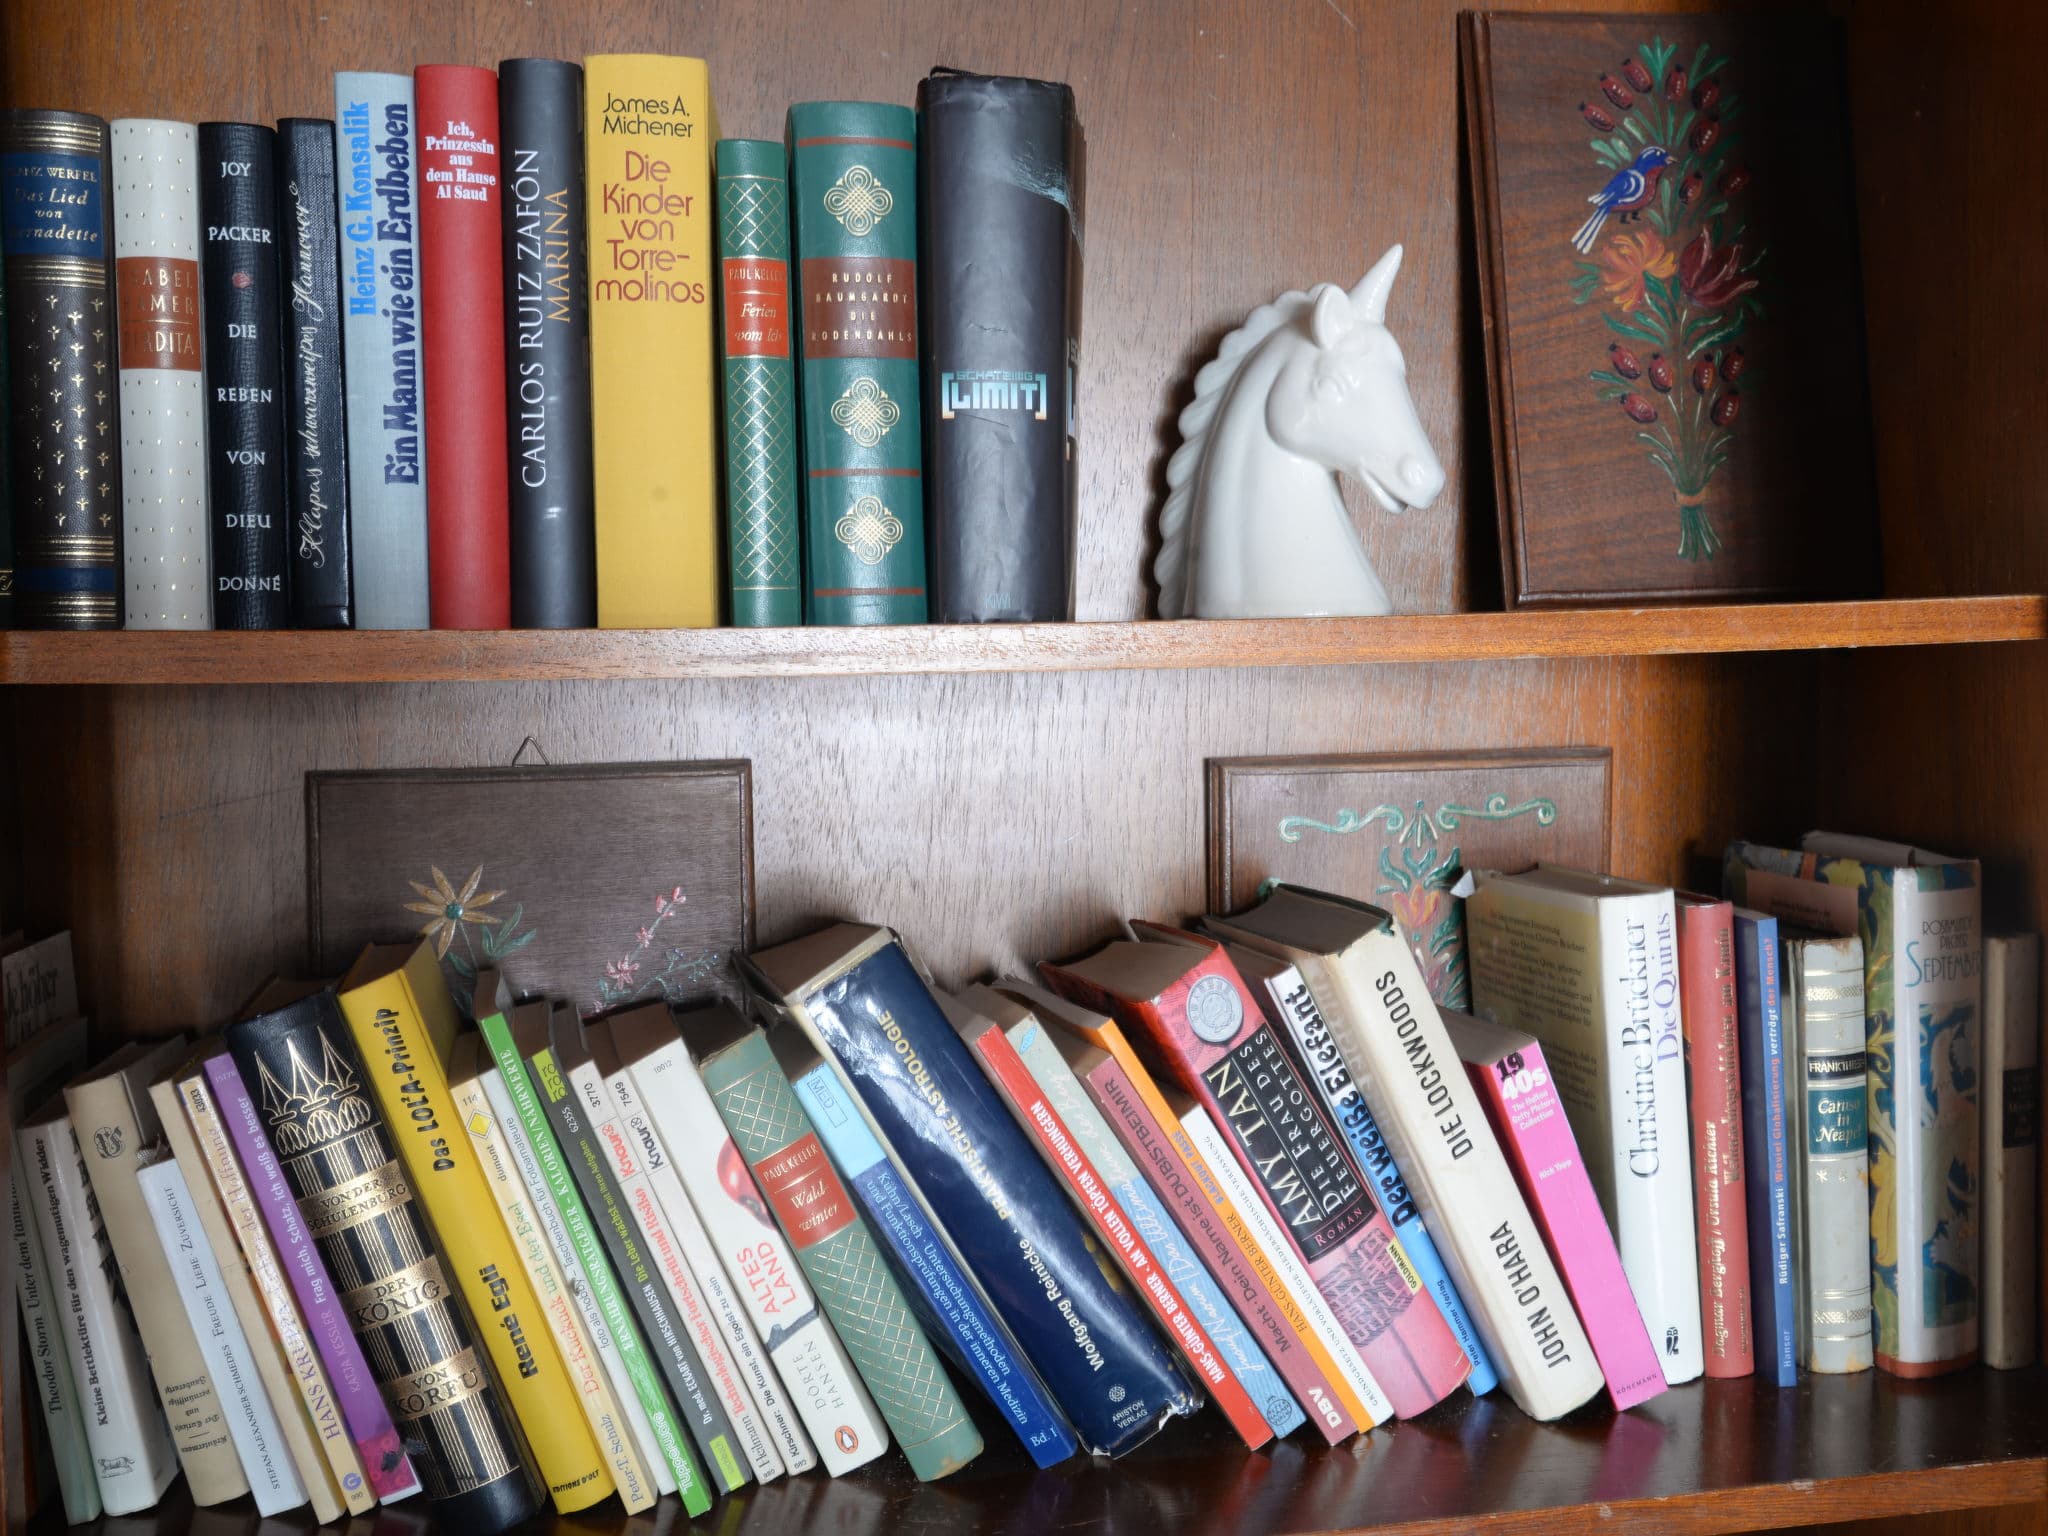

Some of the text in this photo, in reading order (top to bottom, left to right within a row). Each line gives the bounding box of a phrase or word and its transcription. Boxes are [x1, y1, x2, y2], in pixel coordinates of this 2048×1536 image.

[602, 93, 690, 117] James A.
[447, 121, 475, 138] Ich,
[603, 115, 693, 137] Michener
[425, 136, 495, 155] Prinzessin
[449, 153, 473, 166] aus
[46, 168, 97, 183] WERFEL
[220, 161, 252, 178] JOY
[426, 168, 496, 186] dem Hause
[625, 151, 671, 183] Die
[49, 188, 88, 205] Lied
[343, 101, 376, 316] Heinz G. Konsalik
[436, 185, 487, 202] Al Saud
[603, 183, 693, 217] Kinder
[35, 210, 63, 219] von
[620, 219, 674, 241] von
[208, 226, 272, 244] PACKER
[289, 181, 324, 322] Hannover
[544, 188, 571, 323] MARINA
[606, 239, 690, 272] Torre-
[595, 271, 705, 304] molinos
[729, 268, 752, 281] PAUL
[832, 273, 894, 285] RUDOLF
[375, 103, 419, 485] Ein Mann wie ein Erdbeben
[740, 302, 777, 319] Ferien
[815, 291, 909, 304] BAUMGARDT
[228, 323, 256, 339] DIE
[511, 150, 547, 488] CARLOS RUIZ ZAFÓN
[850, 310, 877, 321] DIE
[734, 330, 763, 342] vom
[811, 329, 913, 343] RODENDAHLS
[217, 387, 272, 403] REBEN
[951, 381, 1037, 410] LIMIT
[226, 451, 266, 465] VON
[226, 514, 271, 529] DIEU
[218, 575, 281, 591] DONNÉ
[1648, 911, 1679, 1061] Die Quints
[1237, 1042, 1272, 1088] DES
[1372, 968, 1475, 1160] DIE LOCKWOODS
[1615, 916, 1659, 1178] Christine Brückner
[1497, 1052, 1525, 1082] 19
[1502, 1069, 1547, 1100] 40s
[1809, 1061, 1841, 1073] FRANK
[582, 1081, 601, 1108] 3770
[614, 1080, 633, 1107] 7549
[1281, 983, 1419, 1227] Der Elefant
[497, 1047, 570, 1196] KALORIEN/NÄHRWERTE
[560, 1105, 580, 1133] 62355
[1837, 1113, 1850, 1127] in
[427, 1136, 455, 1174] Das
[483, 1143, 508, 1183] dumont
[605, 1133, 636, 1177] Knaur
[632, 1123, 665, 1170] Knaur
[1204, 1059, 1322, 1234] AMY TAN
[353, 1179, 381, 1196] DER
[763, 1163, 789, 1182] PAUL
[876, 1008, 1107, 1371] Wolfgang Reinicke ASTROLOGIE
[308, 1184, 406, 1231] SCHULENBURG
[791, 1180, 826, 1209] Wald
[877, 1171, 925, 1239] Kühn/Lasch
[1029, 1100, 1179, 1315] BERNER AN VERHUNGERN
[1772, 1187, 1787, 1239] Safranski
[631, 1187, 672, 1257] und Risiko
[799, 1202, 838, 1231] winter
[1225, 1212, 1258, 1257] BERNER
[1315, 1208, 1362, 1246] ROMAN
[234, 1096, 362, 1393] KATJA KESSLER Frag mich, Schatz, ich weiß es besser
[533, 1185, 601, 1327] als für
[1196, 1218, 1233, 1265] Name
[735, 1245, 780, 1318] ALTES
[754, 1238, 797, 1307] LAND
[1225, 1264, 1258, 1301] Dein
[1389, 1245, 1417, 1289] GOLDMANN
[357, 1280, 440, 1328] KÖNIG
[375, 1277, 410, 1298] DER
[865, 1180, 1029, 1424] und in der Medizin
[1485, 1219, 1571, 1370] JOHN O'HARA
[17, 1241, 63, 1415] Theodor Storm Unter dem
[478, 1262, 539, 1379] René Egli
[522, 1236, 600, 1396] Der Kuckuck und der
[605, 1204, 712, 1424] Dr. ECKART von HIRSCHHAUSEN Die Leber wächst
[1253, 1304, 1292, 1352] Macht
[1448, 1307, 1471, 1342] Hammer
[63, 1268, 109, 1426] Kleine für den
[1324, 1325, 1341, 1346] UND
[1780, 1328, 1793, 1367] Hanser
[398, 1368, 478, 1416] KORFU
[412, 1367, 448, 1389] VON
[720, 1297, 800, 1457] Kirschner: Die ein zu
[792, 1352, 826, 1410] DÖRTE
[804, 1339, 844, 1408] HANSEN
[306, 1382, 341, 1440] HANS
[1112, 1400, 1144, 1423] ARISTON
[1117, 1409, 1148, 1429] VERLAG
[1308, 1387, 1342, 1429] DBV
[240, 1395, 280, 1490] STEFAN ALEXANDER
[652, 1408, 697, 1493] Tupperware
[1030, 1432, 1051, 1447] Bd.
